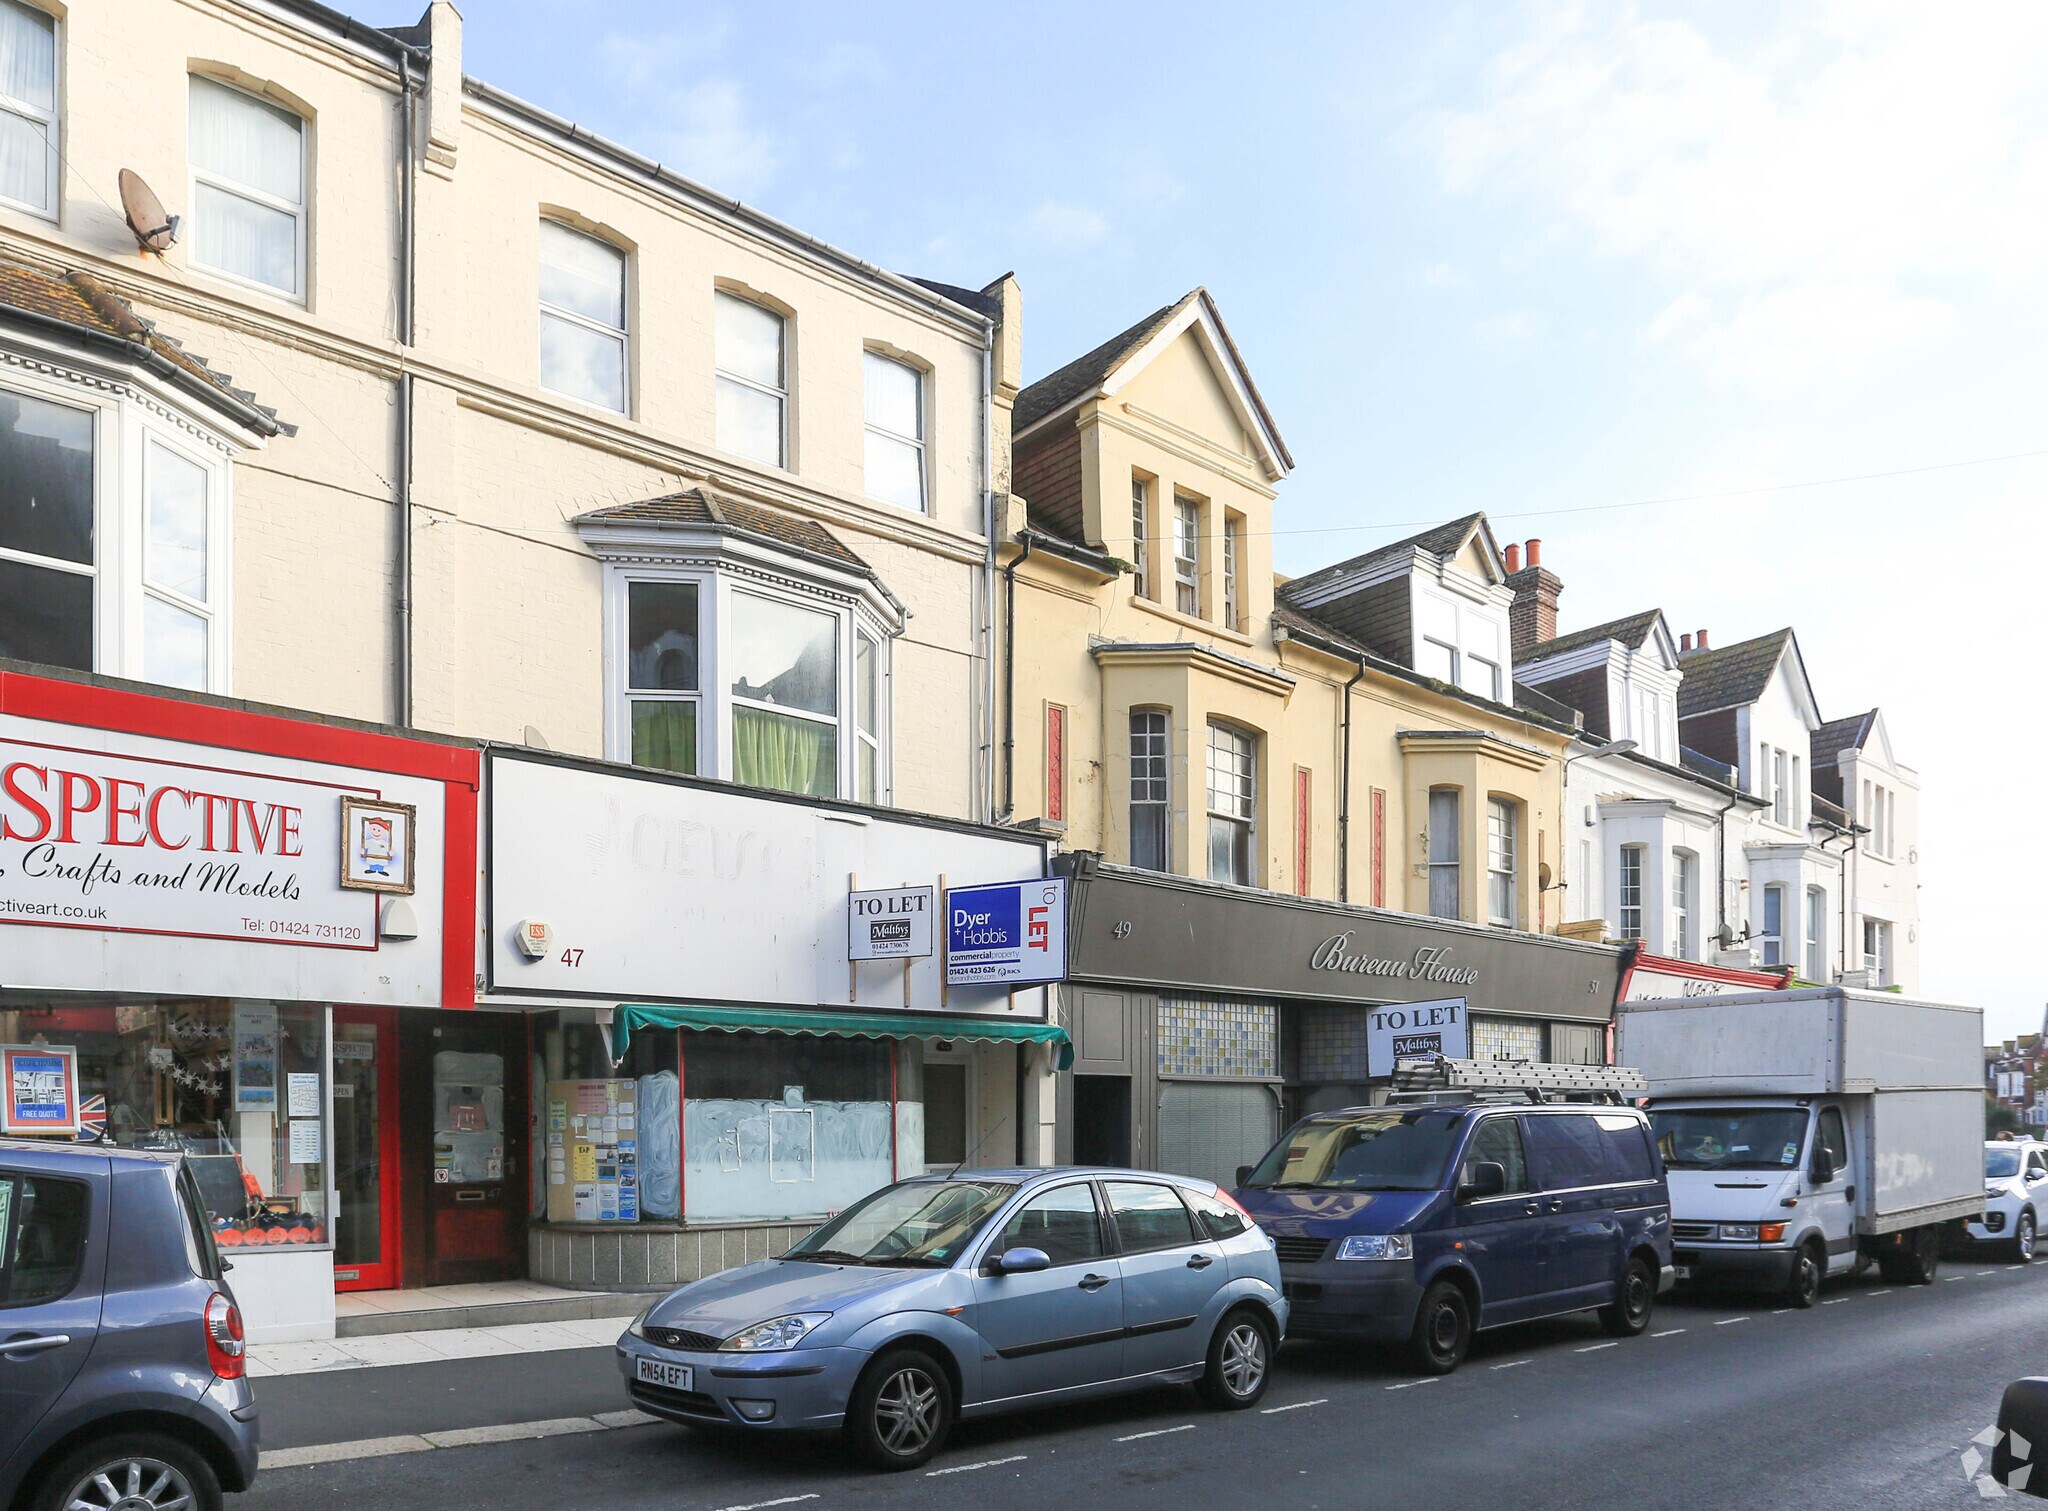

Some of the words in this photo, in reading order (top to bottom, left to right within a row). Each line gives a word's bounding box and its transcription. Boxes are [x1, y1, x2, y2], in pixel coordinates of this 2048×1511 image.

[0, 762, 303, 857] SPECTIVE
[22, 843, 121, 895] Crafts
[128, 862, 192, 891] and
[196, 861, 300, 900] Models
[854, 898, 883, 915] TO
[887, 894, 928, 914] LET
[241, 917, 264, 932] Tel:
[269, 920, 310, 936] 01424
[315, 924, 361, 940] 731120
[954, 909, 991, 930] Dyer
[1029, 907, 1048, 952] LET
[1113, 920, 1132, 940] 49
[530, 925, 545, 937] ESS
[872, 923, 909, 938] Maltbys
[963, 928, 1008, 946] Hobbis
[560, 948, 584, 968] 47
[1311, 930, 1408, 977] Bureau
[1408, 946, 1479, 985] House
[949, 967, 969, 976] 01424
[969, 967, 982, 975] 423
[982, 966, 996, 974] 626
[1371, 1011, 1406, 1030] TO
[1412, 1005, 1460, 1028] LET
[1395, 1037, 1439, 1053] Maltbys
[38, 1110, 58, 1118] QUOTE
[641, 1361, 666, 1382] RN54
[667, 1367, 688, 1387] EFT
